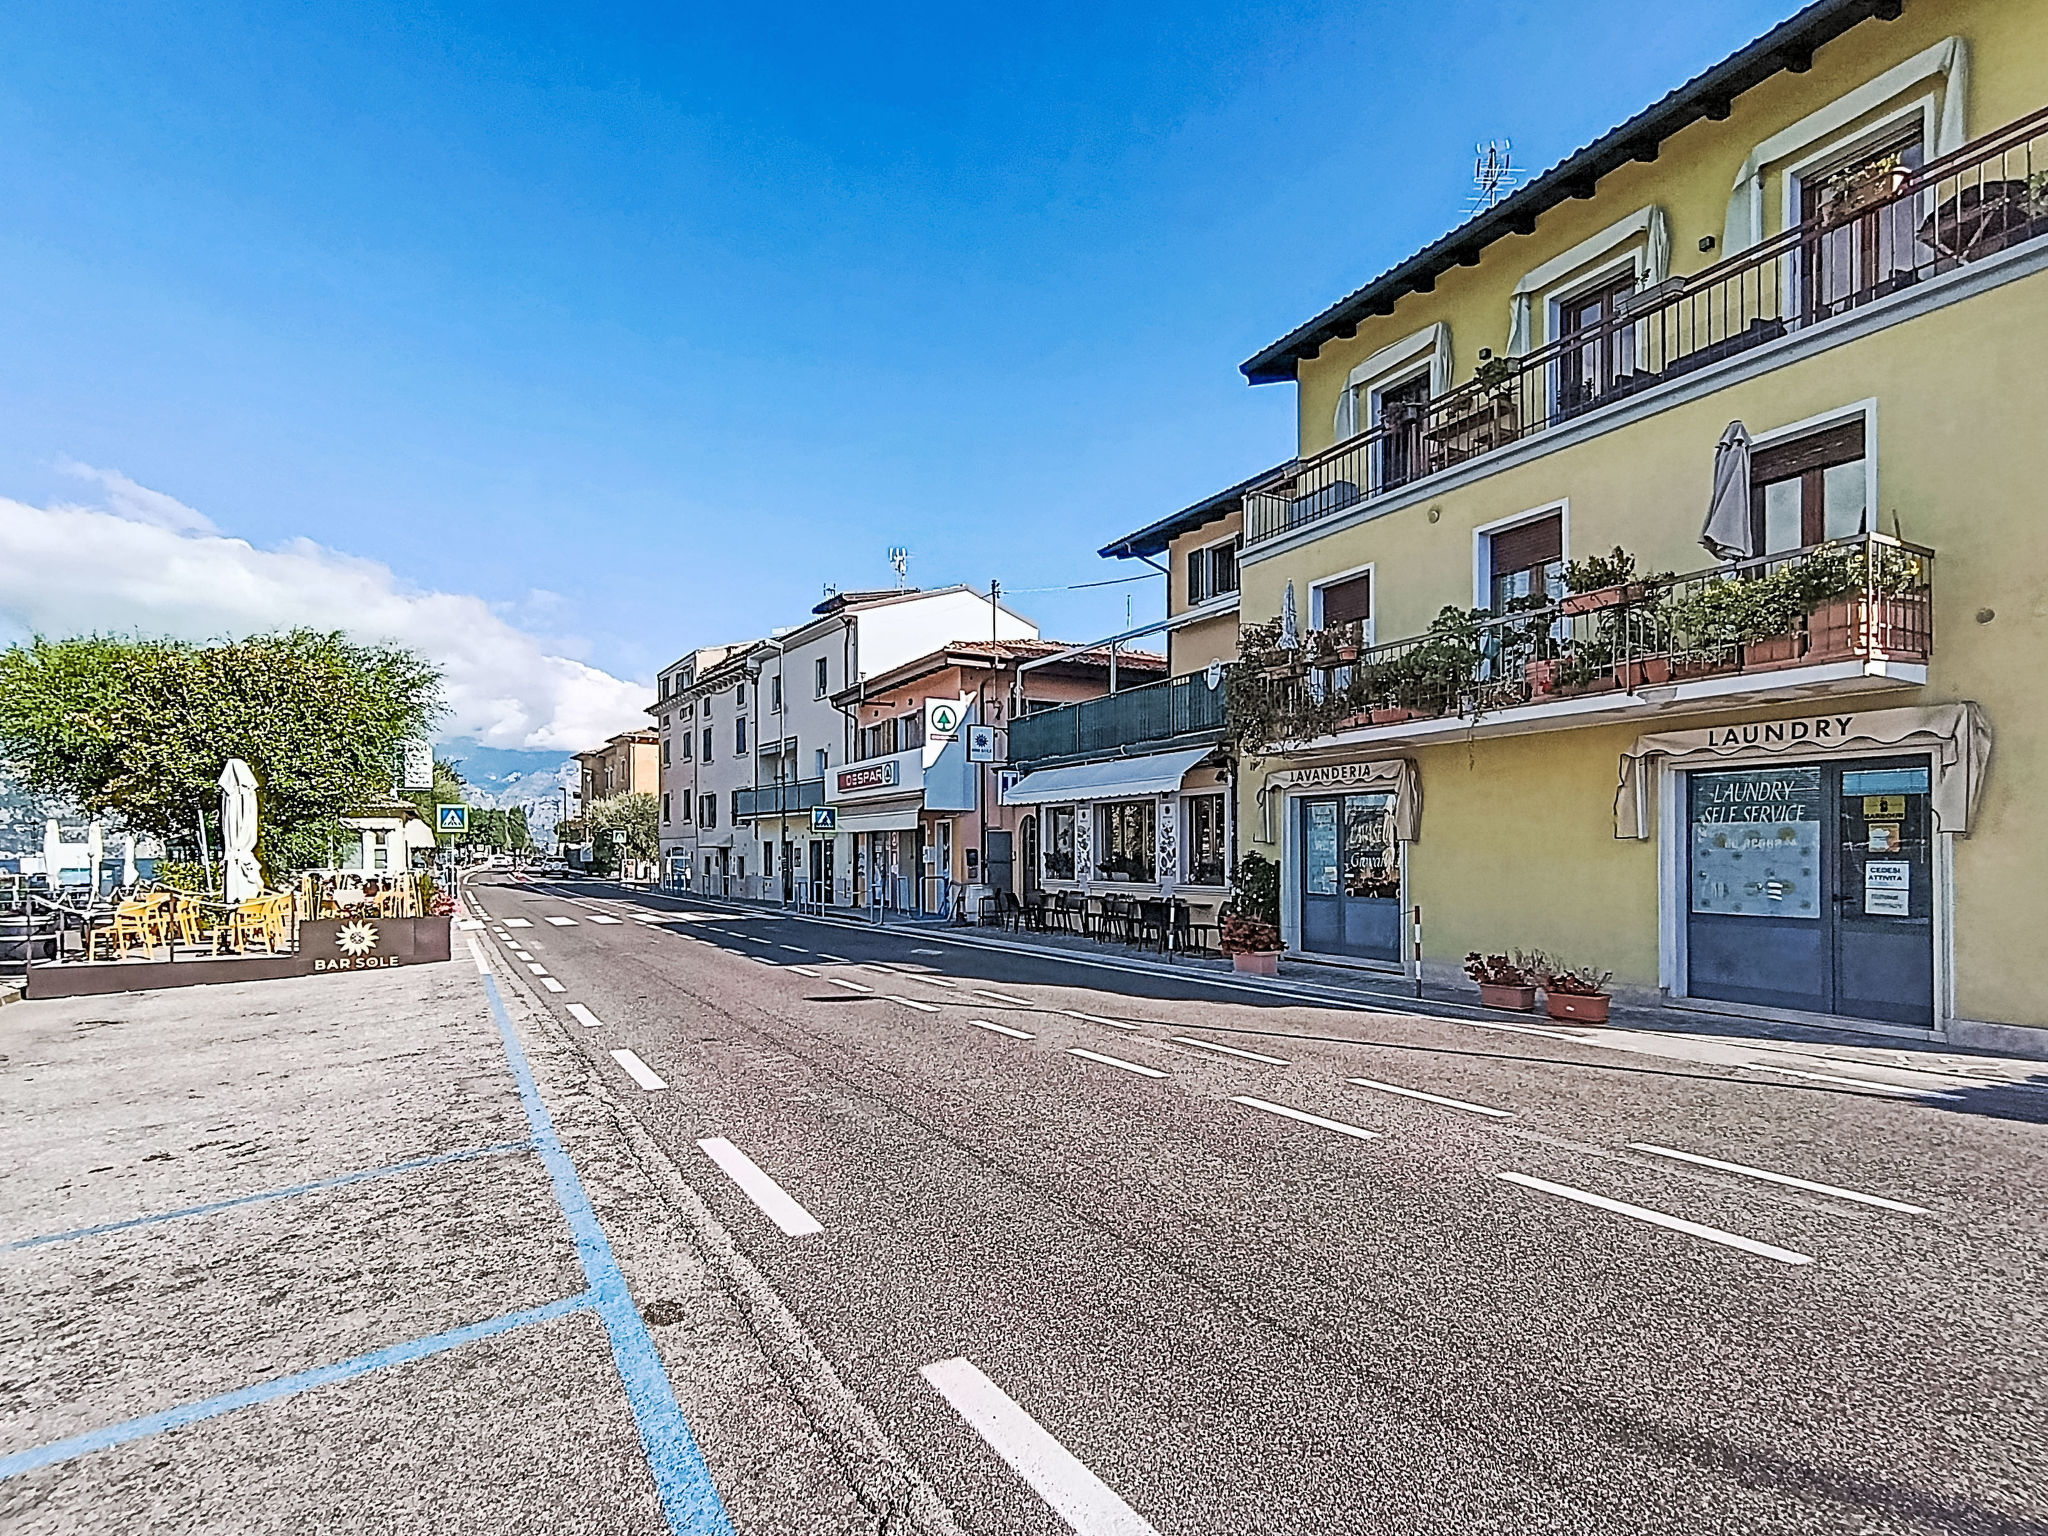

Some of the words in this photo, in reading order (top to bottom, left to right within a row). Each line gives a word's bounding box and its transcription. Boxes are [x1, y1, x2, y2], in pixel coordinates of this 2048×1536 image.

[1709, 717, 1853, 746] LAUNDRY
[846, 769, 882, 786] DESPAR
[1290, 765, 1370, 782] LAVANDERIA
[1714, 781, 1795, 803] LAUNDRY
[1705, 806, 1737, 824] SELF
[1743, 805, 1806, 824] SERVICE
[314, 958, 350, 971] BAR
[356, 956, 399, 969] SOLE
